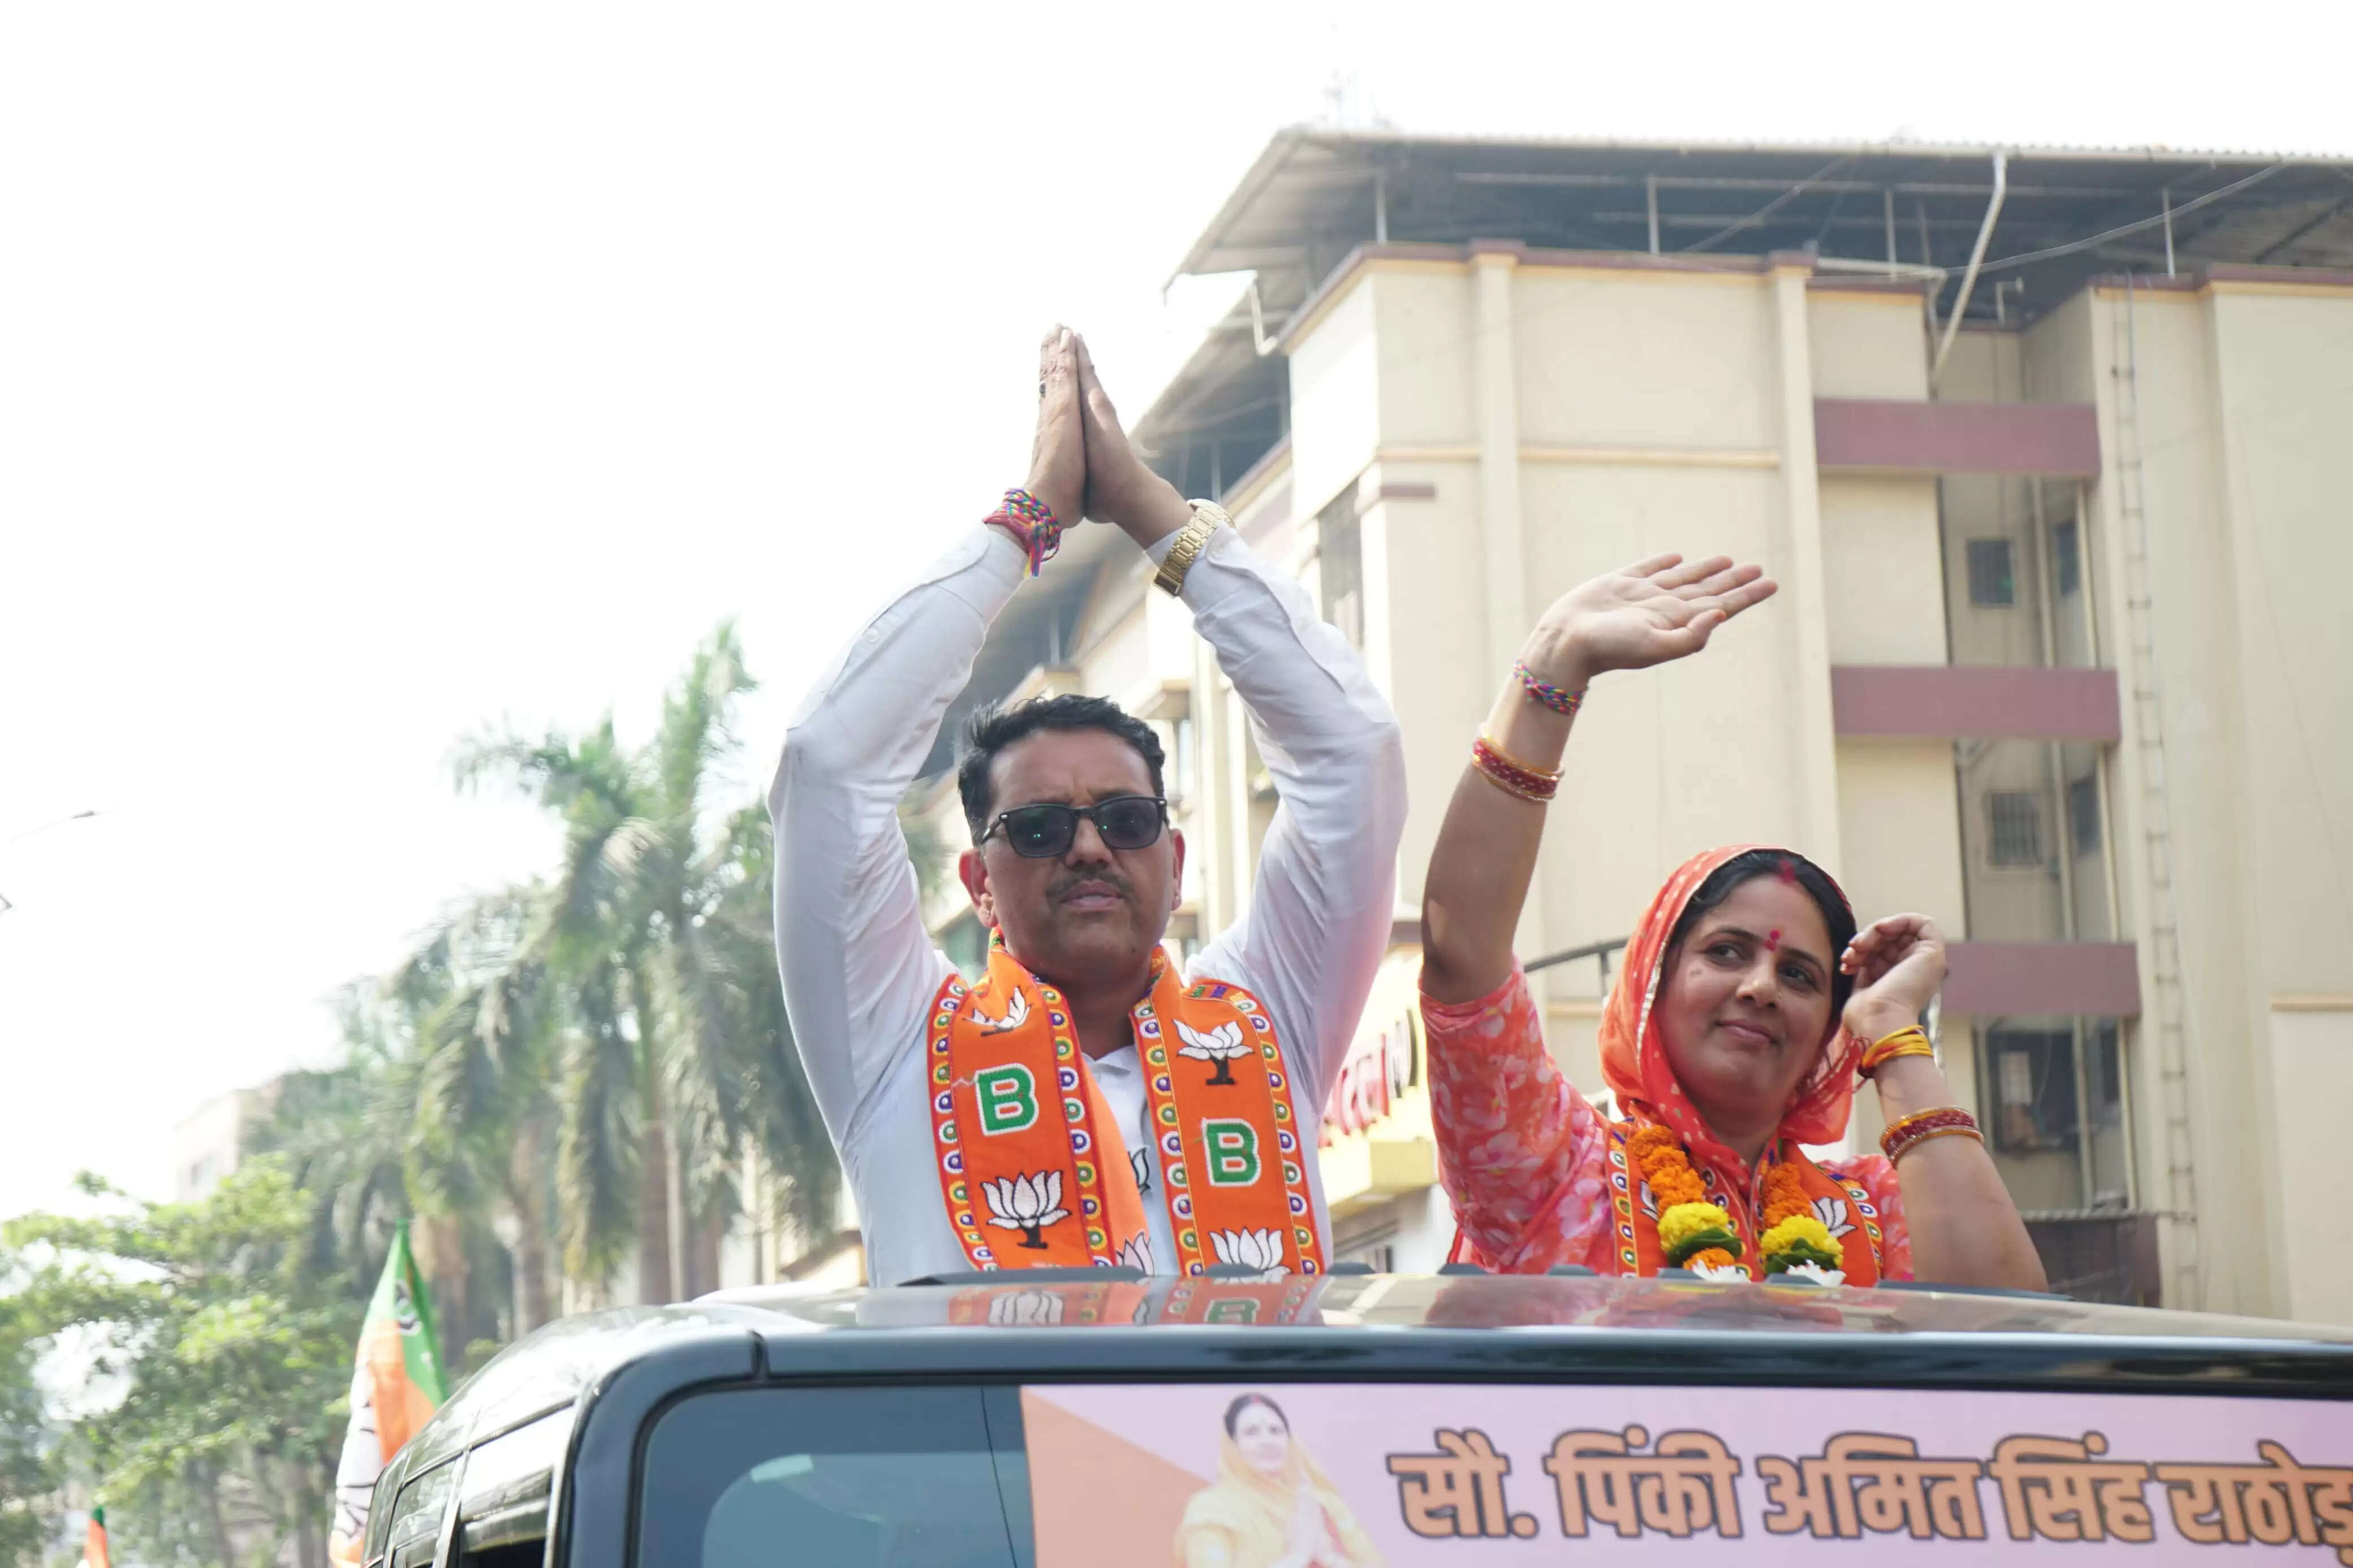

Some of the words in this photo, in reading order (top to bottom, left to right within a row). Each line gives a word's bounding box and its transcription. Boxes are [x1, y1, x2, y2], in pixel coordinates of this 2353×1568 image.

[973, 1063, 1039, 1137] B
[1201, 1118, 1261, 1186] B
[1386, 1428, 1540, 1539] सौ.
[1541, 1424, 1743, 1539] पिंकी
[1755, 1431, 1987, 1541] अमित
[1987, 1430, 2157, 1543] सिंह
